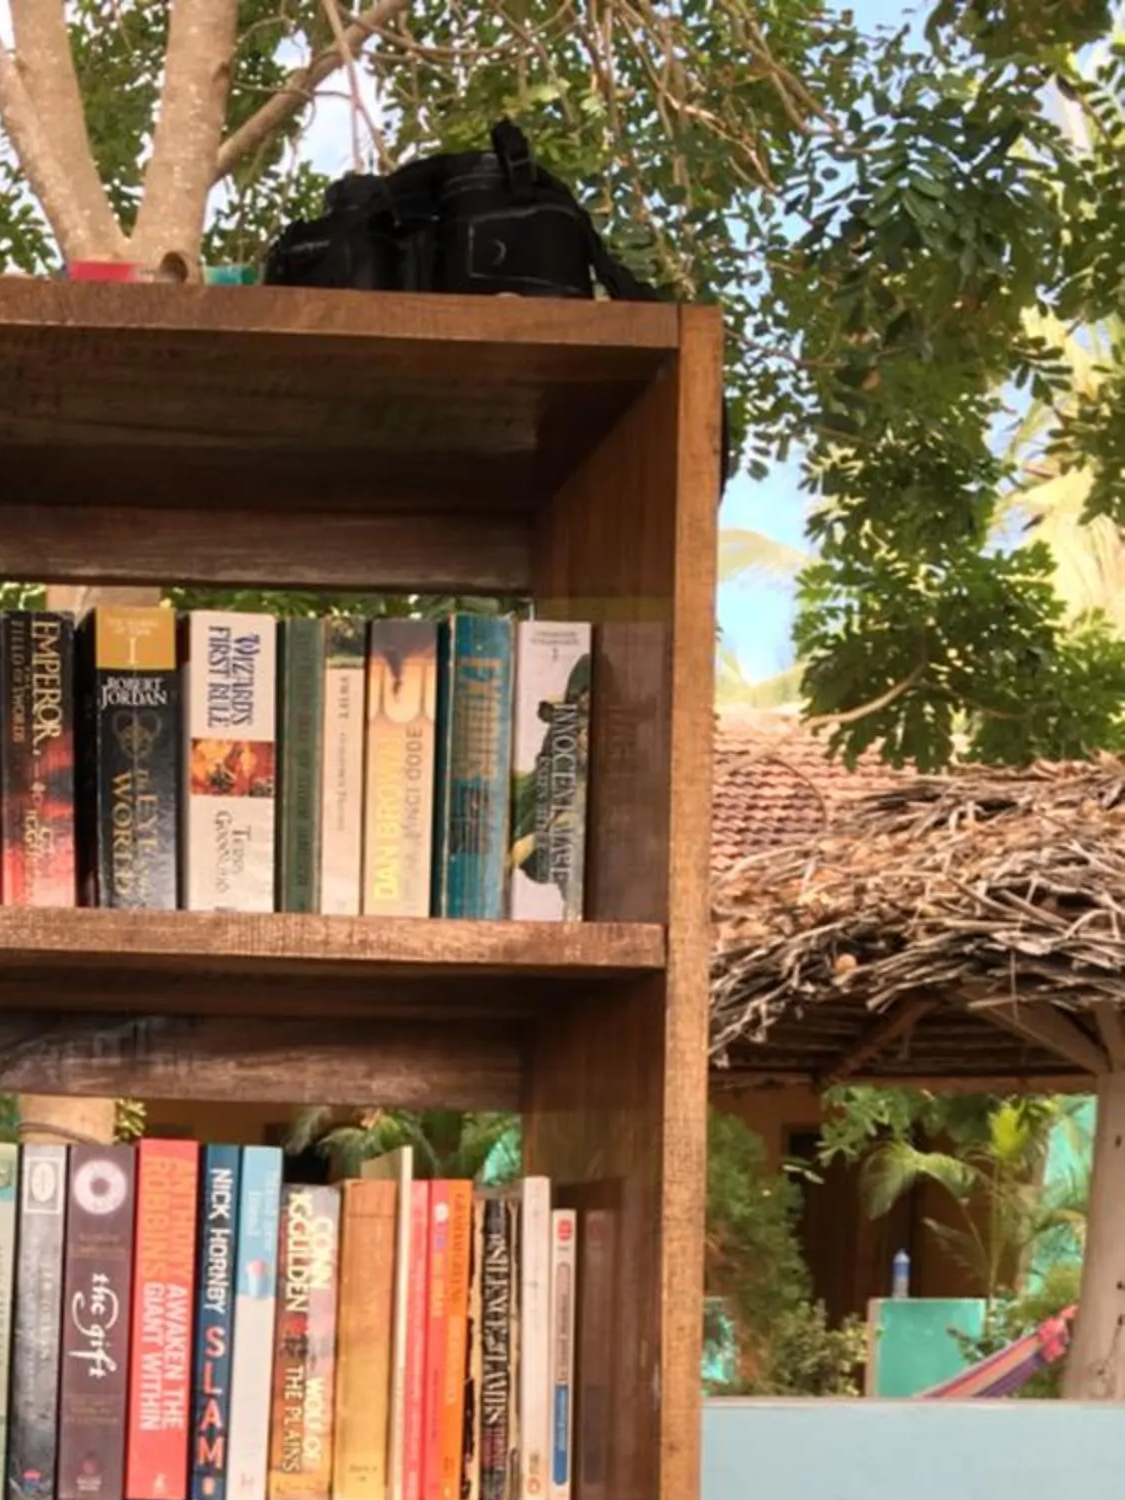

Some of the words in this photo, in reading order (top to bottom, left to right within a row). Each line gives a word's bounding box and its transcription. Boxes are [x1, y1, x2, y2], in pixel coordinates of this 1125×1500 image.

[32, 620, 62, 744] EMPEROR
[208, 626, 232, 677] FIRST
[207, 683, 231, 728] RULE
[373, 846, 398, 900] DAN
[144, 1154, 173, 1280] ROBBINS
[210, 1167, 232, 1220] NICK
[204, 1227, 231, 1313] HORNBY
[286, 1191, 312, 1312] IGGULDEN
[311, 1216, 334, 1290] CONN
[142, 1282, 164, 1346] GIANT
[165, 1283, 186, 1380] AWAKEN
[140, 1351, 162, 1430] WITHIN
[165, 1388, 185, 1429] THE
[198, 1326, 226, 1467] SLAM
[289, 1365, 305, 1400] THE
[282, 1406, 305, 1472] PLAINS
